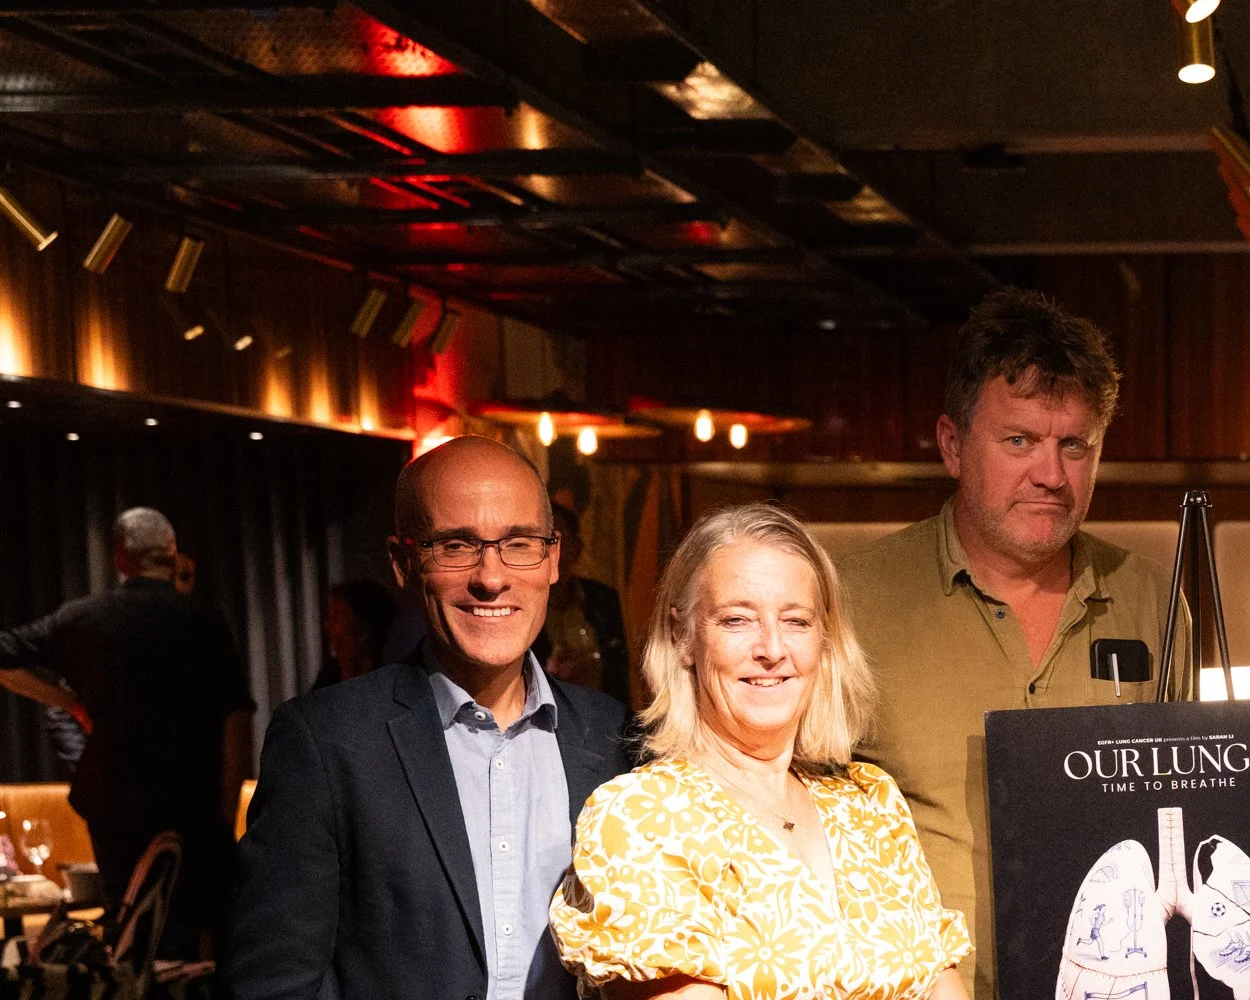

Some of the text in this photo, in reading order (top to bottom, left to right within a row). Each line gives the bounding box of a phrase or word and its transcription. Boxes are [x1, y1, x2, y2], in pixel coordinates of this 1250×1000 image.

[1064, 748, 1144, 780] OUR
[1102, 777, 1236, 792] TIME TO BREATHE
